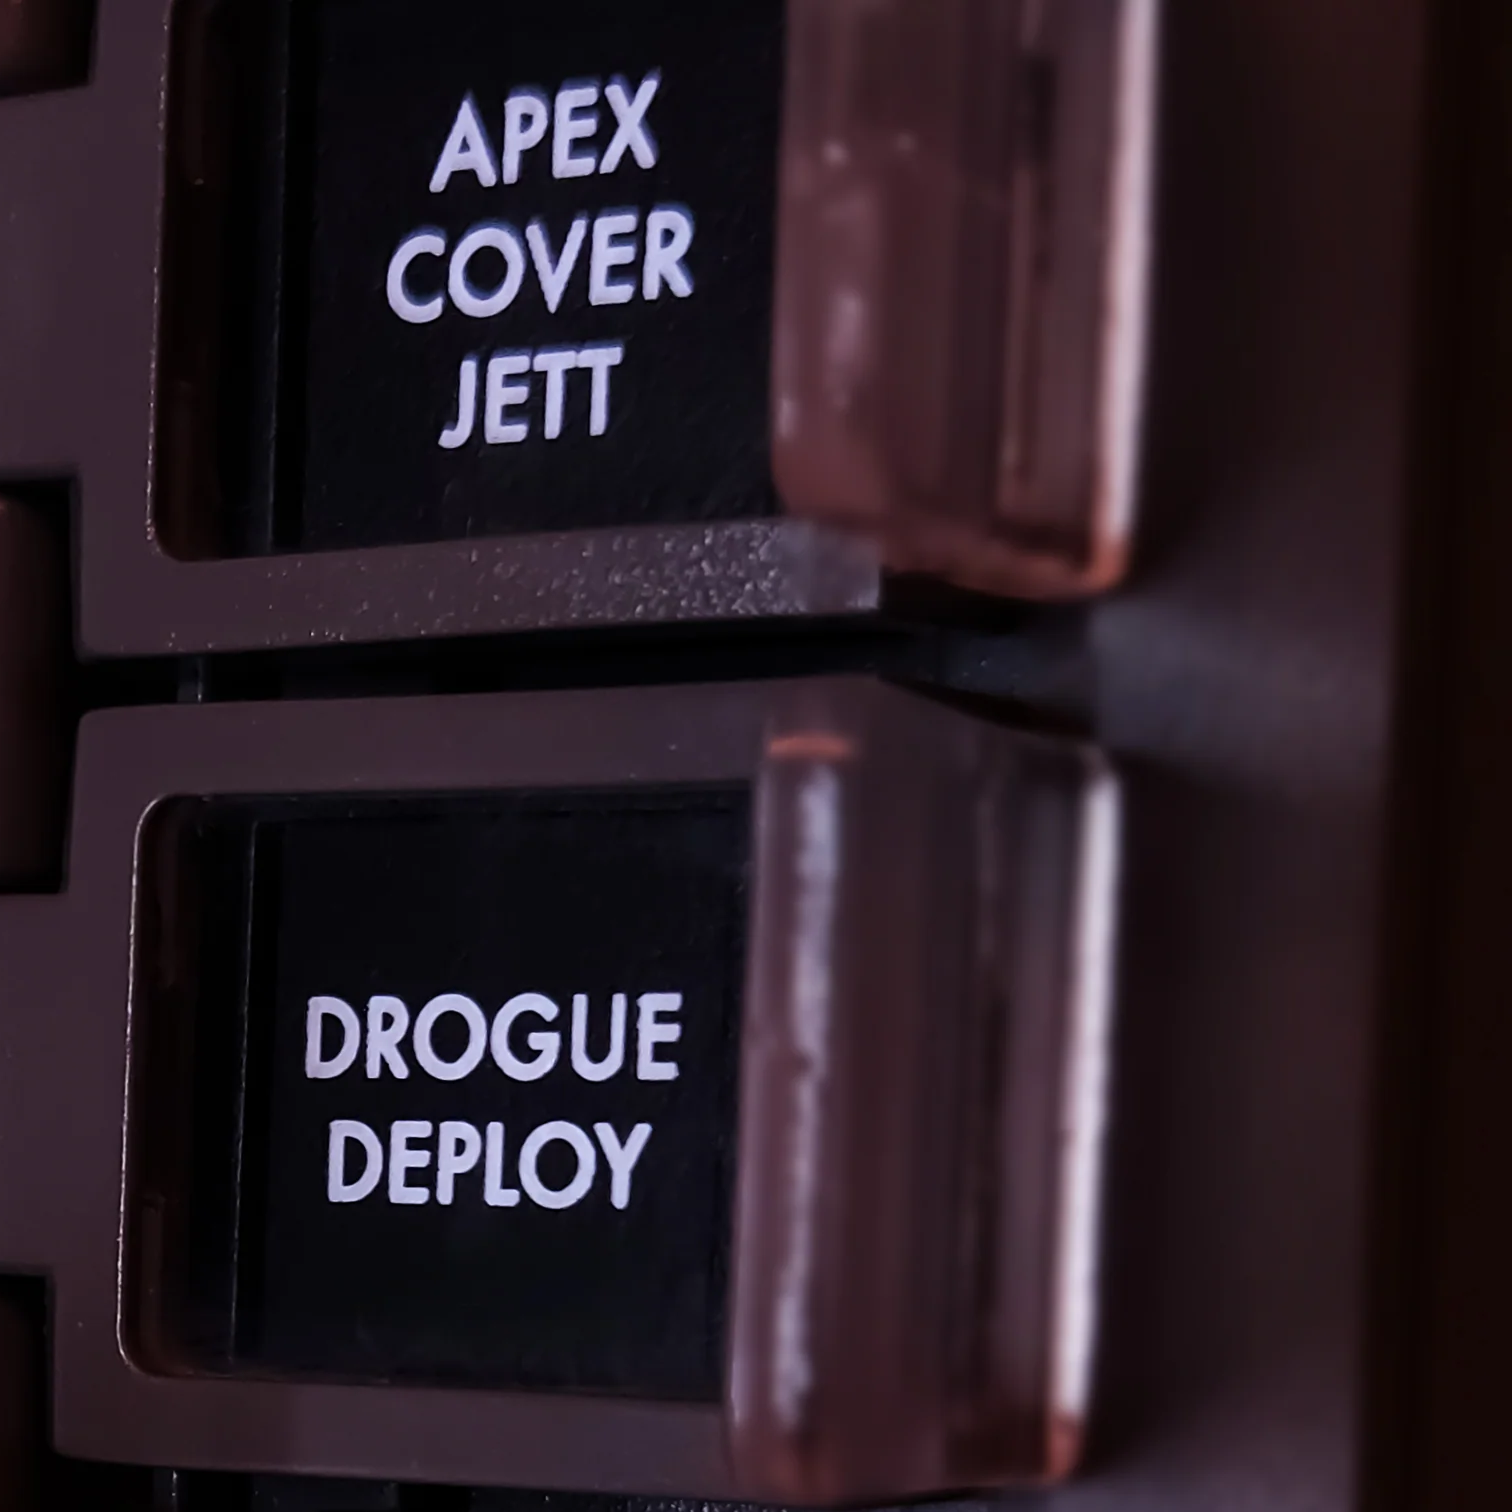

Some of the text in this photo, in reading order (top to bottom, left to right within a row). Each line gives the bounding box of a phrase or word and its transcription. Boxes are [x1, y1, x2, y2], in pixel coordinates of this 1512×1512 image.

[428, 70, 660, 194] APEX
[387, 204, 694, 324] COVER
[437, 340, 625, 450] JETT
[304, 992, 683, 1082] DROGUE
[327, 1119, 652, 1210] DEPLOY
